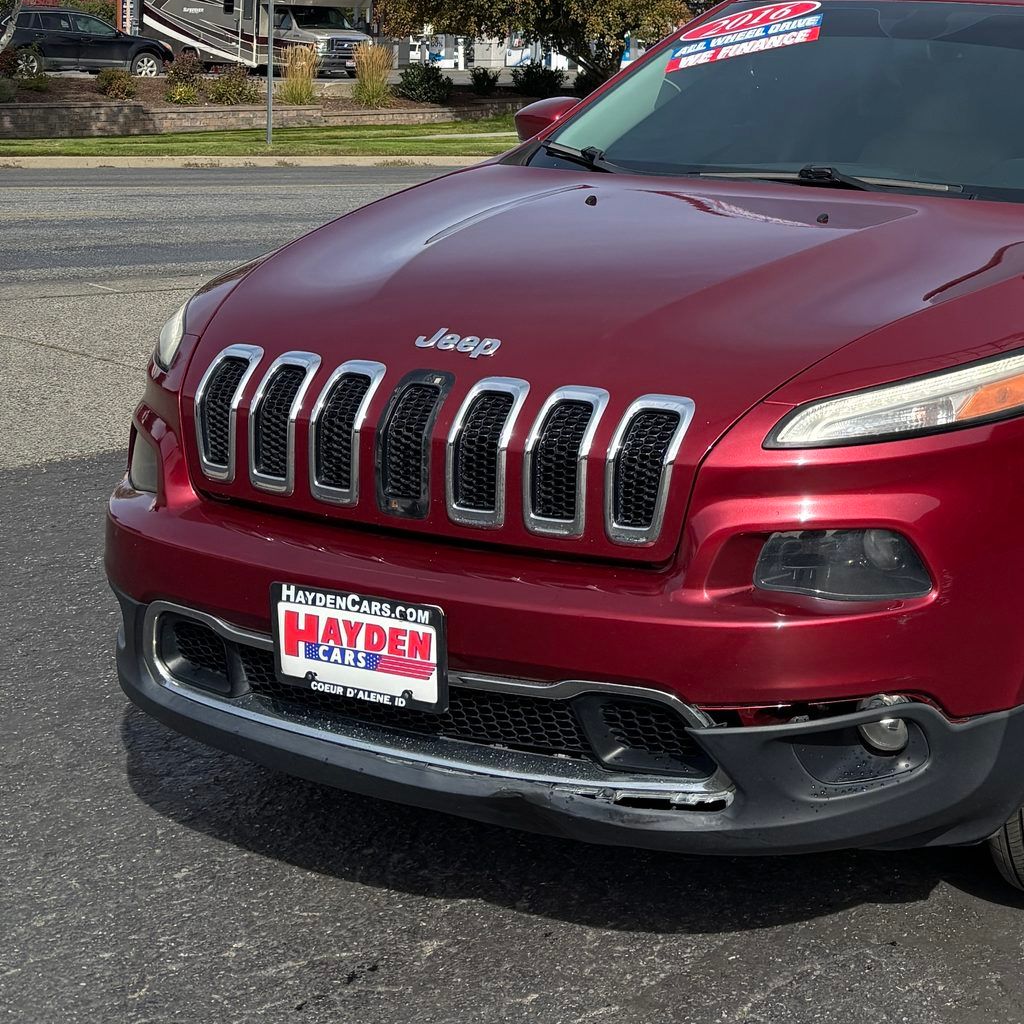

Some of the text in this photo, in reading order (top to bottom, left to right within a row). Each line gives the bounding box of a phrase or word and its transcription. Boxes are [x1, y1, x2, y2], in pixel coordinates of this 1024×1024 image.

[704, 6, 793, 35] 2016
[674, 15, 823, 58] ALL WHEEL DRIVE
[678, 29, 813, 69] WE FINANCE
[414, 327, 501, 358] Jeep
[284, 609, 433, 661] HAYDEN
[317, 644, 367, 668] CARS
[310, 680, 344, 696] COEUR
[394, 697, 406, 707] ID
